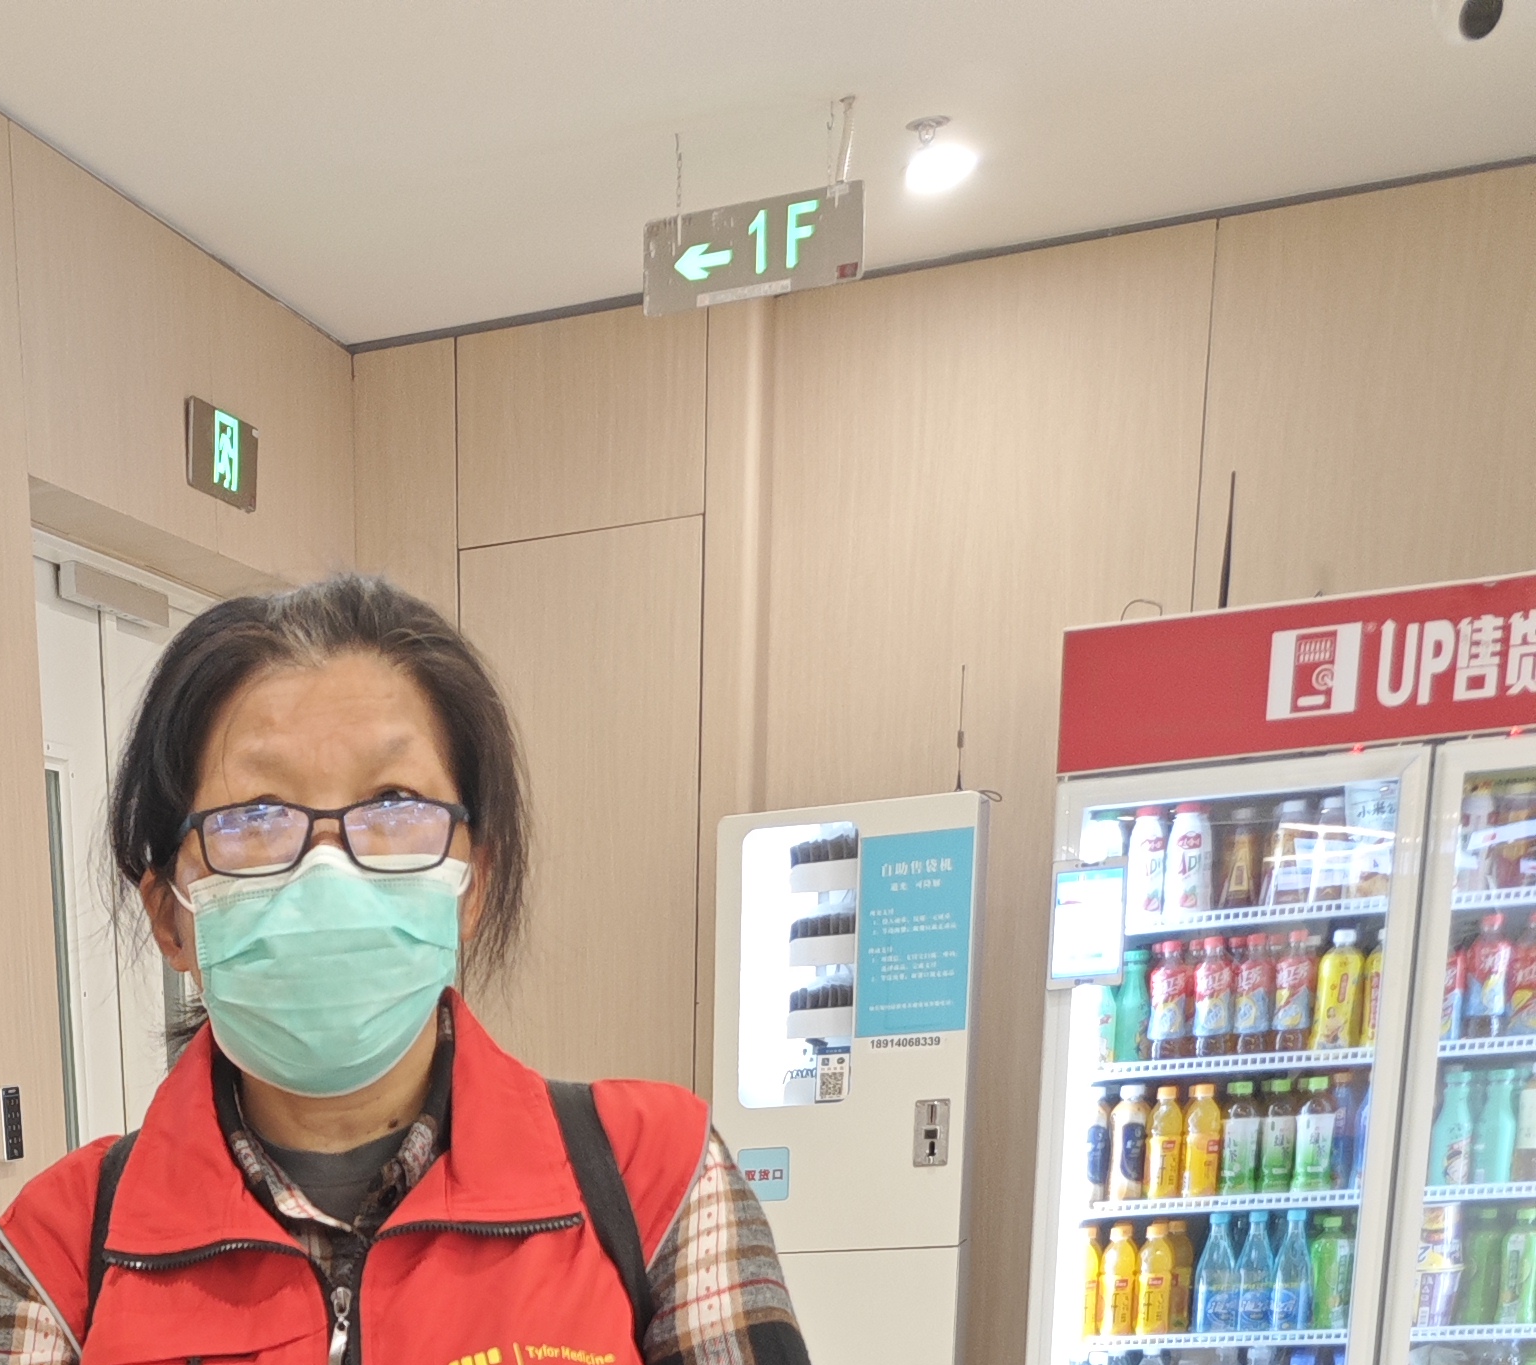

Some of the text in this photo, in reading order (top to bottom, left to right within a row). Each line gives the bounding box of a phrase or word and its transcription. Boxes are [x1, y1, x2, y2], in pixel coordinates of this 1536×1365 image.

[748, 199, 820, 274] 1F
[870, 1036, 941, 1049] 18914068339
[744, 1169, 784, 1181] 取货口
[561, 1345, 616, 1365] Medicine
